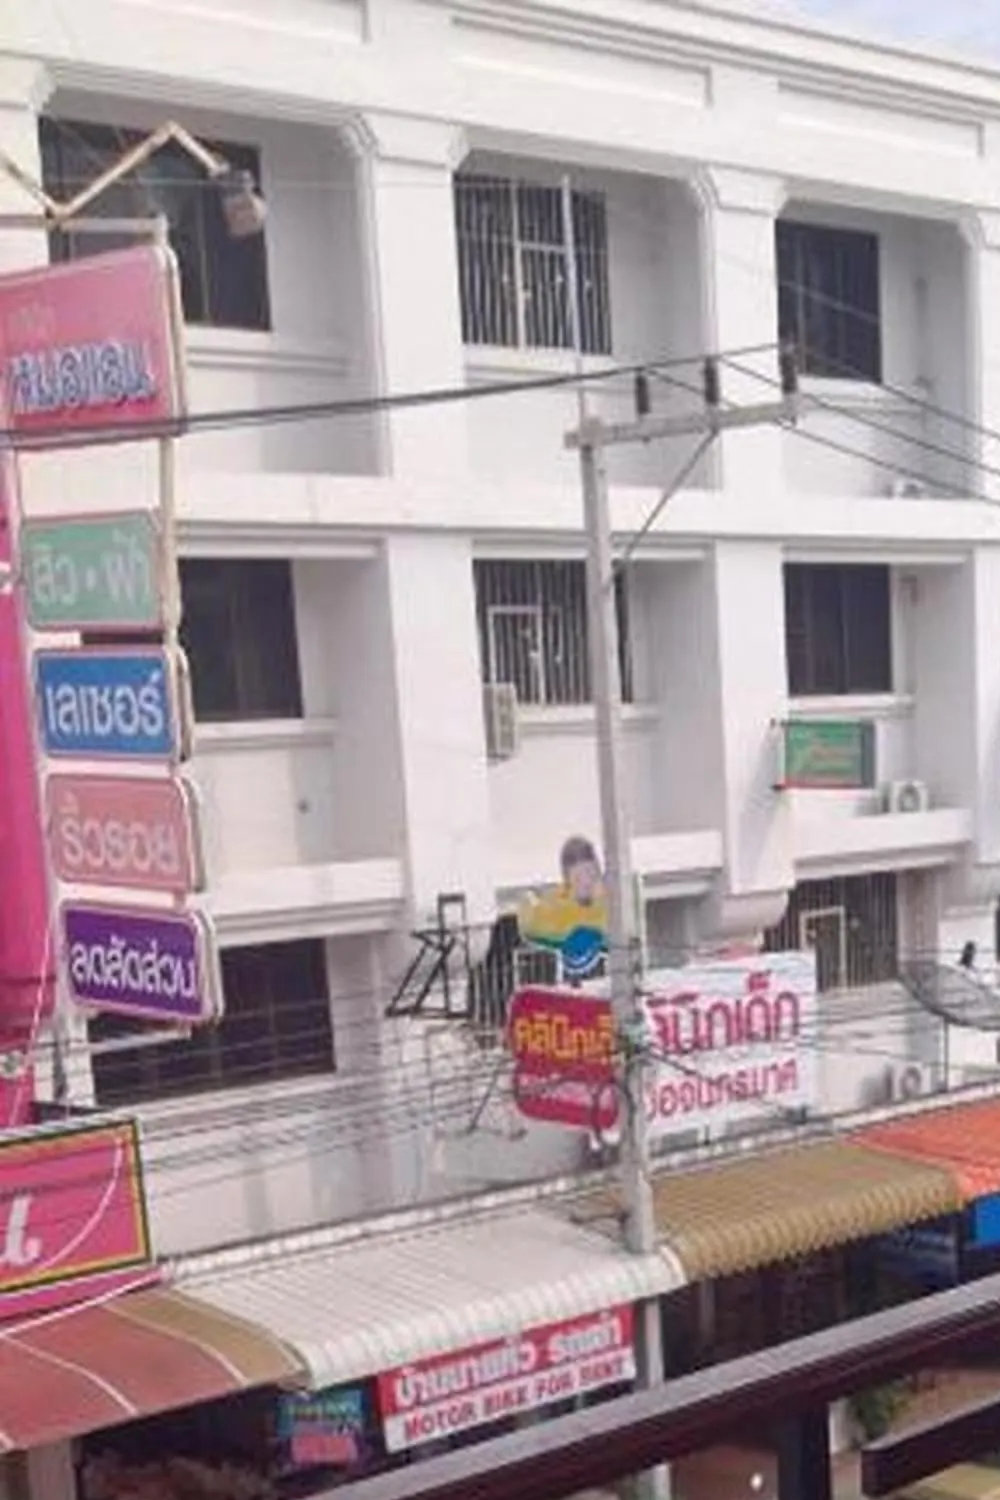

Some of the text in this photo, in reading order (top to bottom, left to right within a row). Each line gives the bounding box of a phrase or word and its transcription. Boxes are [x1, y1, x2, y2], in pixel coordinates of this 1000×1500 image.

[70, 934, 196, 998] ลดสัดส่วน
[403, 1400, 478, 1442] MOTOR
[482, 1384, 531, 1419] BIKE
[536, 1371, 575, 1401] FOR
[579, 1355, 627, 1387] RENT
